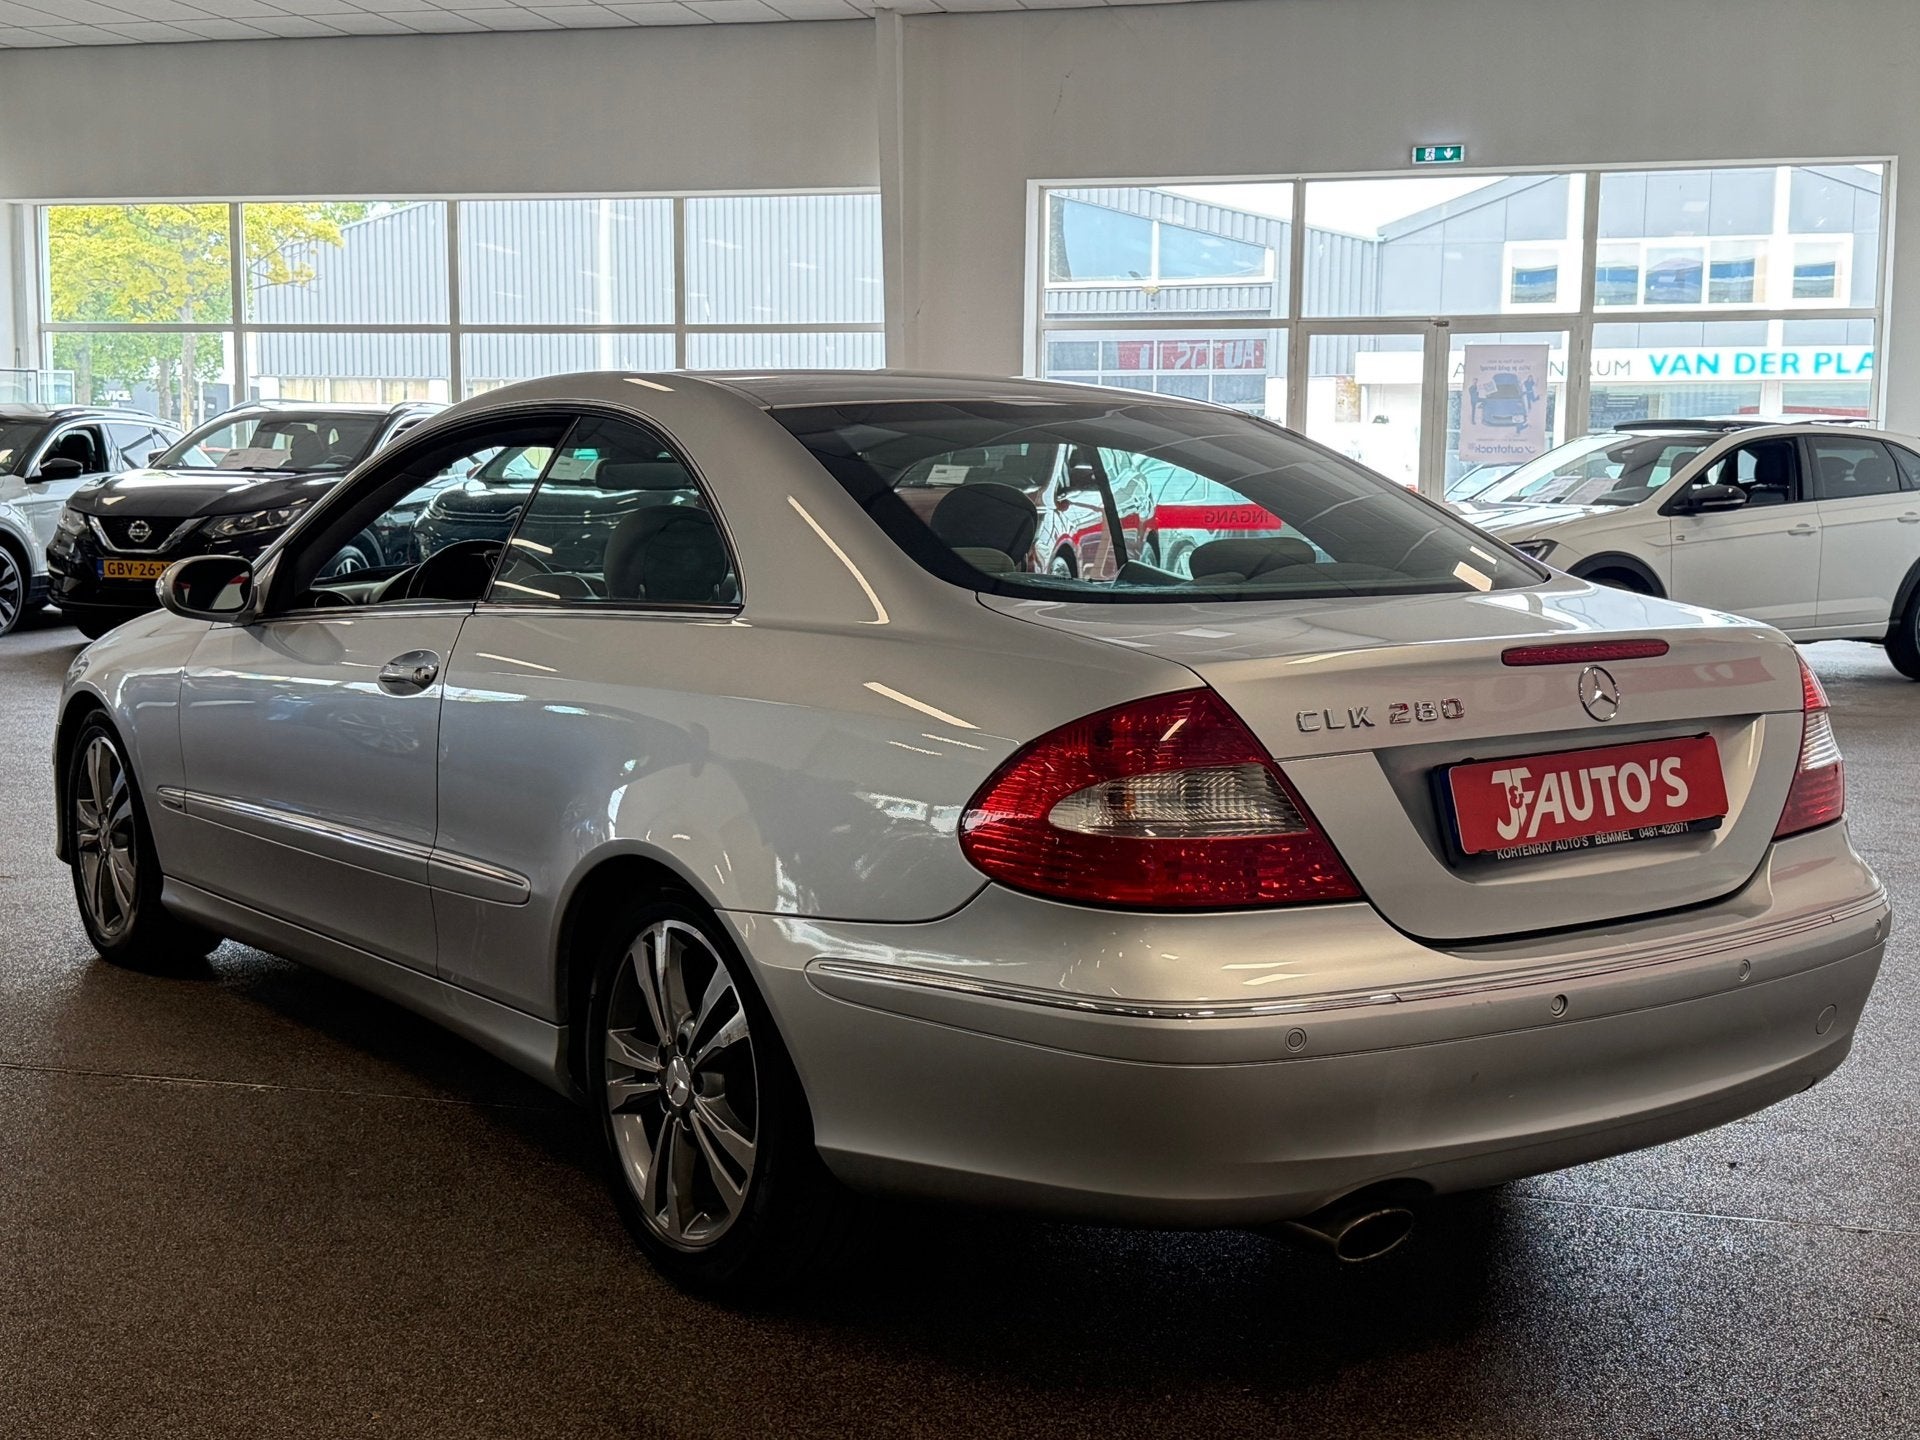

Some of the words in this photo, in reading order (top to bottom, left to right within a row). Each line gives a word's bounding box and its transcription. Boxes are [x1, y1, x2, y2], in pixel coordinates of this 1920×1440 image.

[1649, 353, 1720, 375] VAN
[1734, 353, 1800, 374] DER
[1296, 706, 1376, 732] CLK
[1389, 698, 1466, 725] 280
[1497, 842, 1554, 860] KORTENRAY
[1555, 836, 1589, 851] AUTO'S
[1595, 830, 1634, 845] BEMMEL
[1638, 822, 1689, 839] 0481-422071
